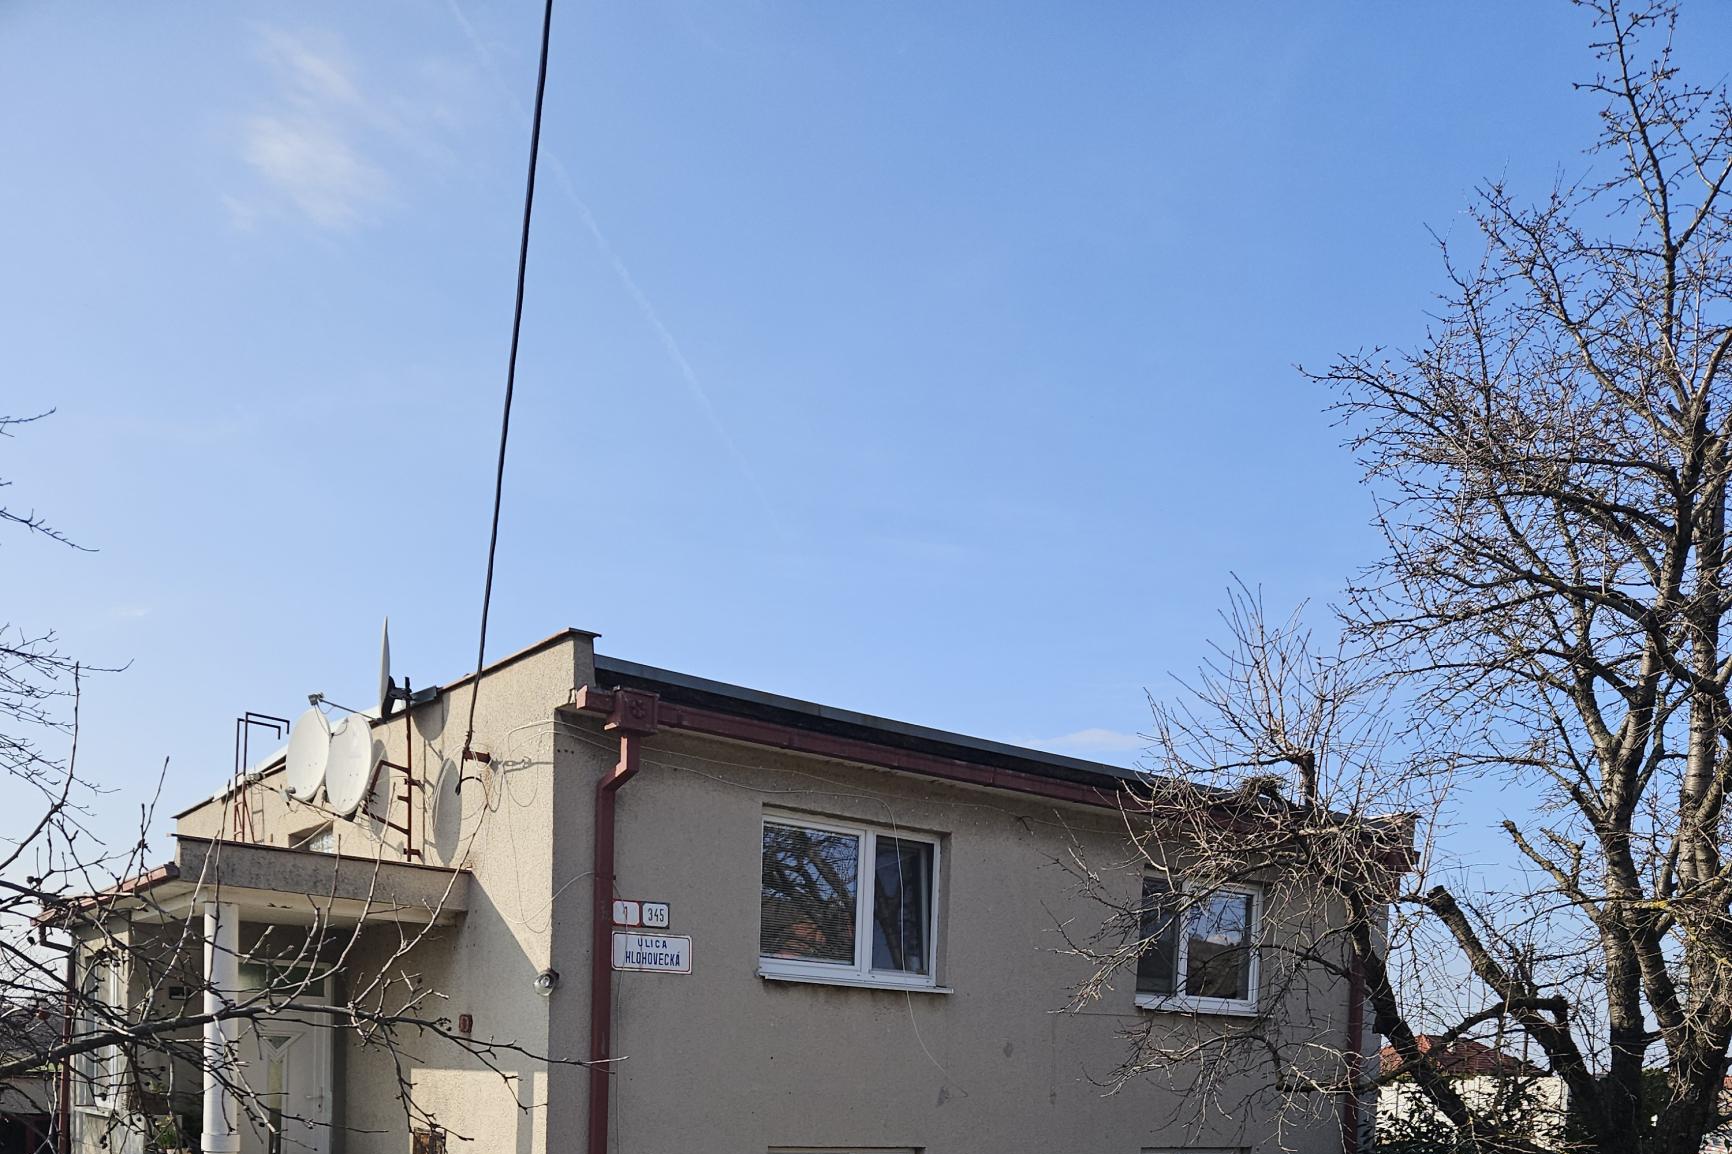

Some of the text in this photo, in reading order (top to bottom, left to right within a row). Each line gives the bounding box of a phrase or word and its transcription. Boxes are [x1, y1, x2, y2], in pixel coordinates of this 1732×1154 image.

[647, 907, 665, 922] 345
[637, 937, 668, 949] ULICA
[625, 950, 681, 967] HLOHOVECKÁ
